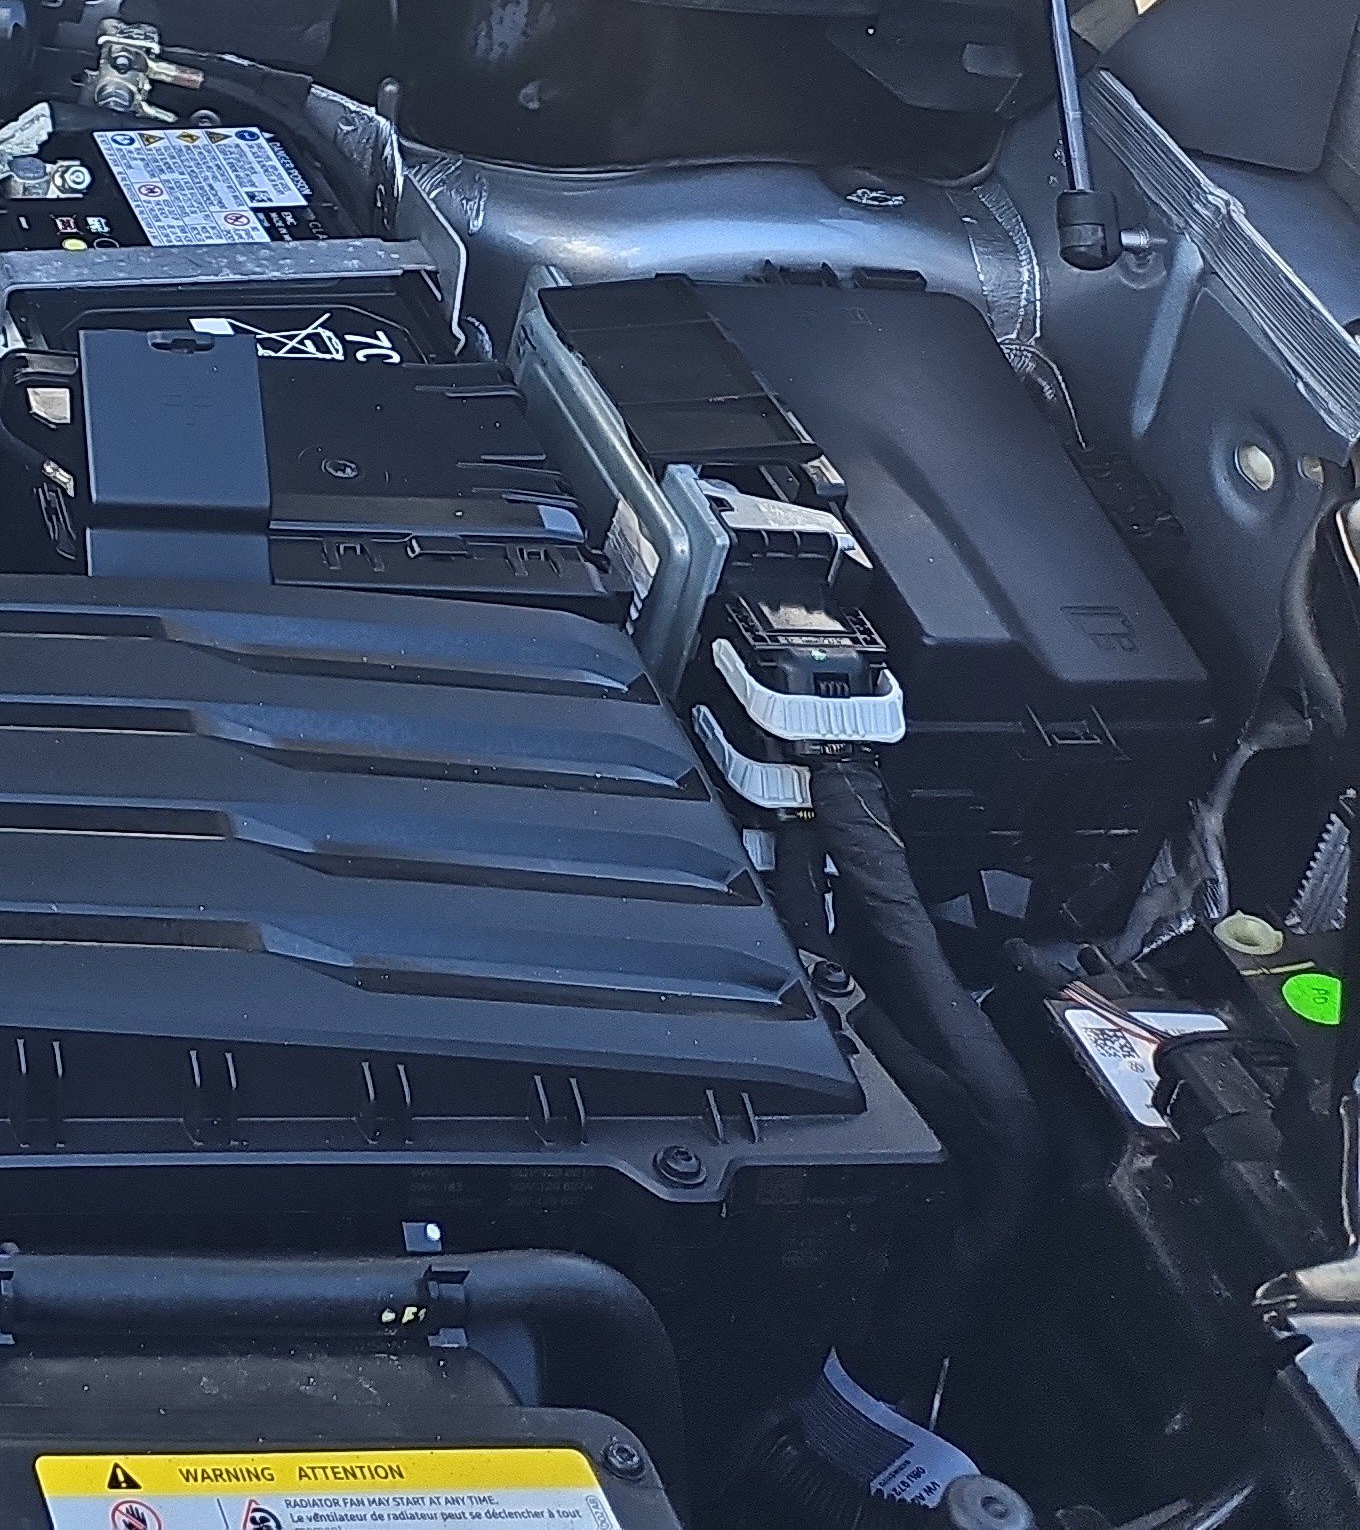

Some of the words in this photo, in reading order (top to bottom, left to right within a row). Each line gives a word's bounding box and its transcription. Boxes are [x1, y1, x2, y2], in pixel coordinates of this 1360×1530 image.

[178, 1466, 276, 1483] WARNING
[297, 1464, 406, 1482] ATTENTION
[284, 1498, 341, 1509] RADIATOR
[342, 1497, 365, 1508] FAN
[366, 1496, 391, 1508] MAY
[392, 1496, 427, 1507] START
[429, 1496, 443, 1507] AT
[444, 1495, 467, 1506] ANY
[290, 1512, 305, 1523] Le
[306, 1511, 369, 1523] ventilateur
[370, 1511, 384, 1522] de
[386, 1511, 439, 1522] radiateur
[441, 1511, 467, 1523] peut
[468, 1512, 482, 1521] se
[484, 1509, 546, 1521] déclencher
[548, 1508, 555, 1519] à
[556, 1509, 582, 1519] tout
